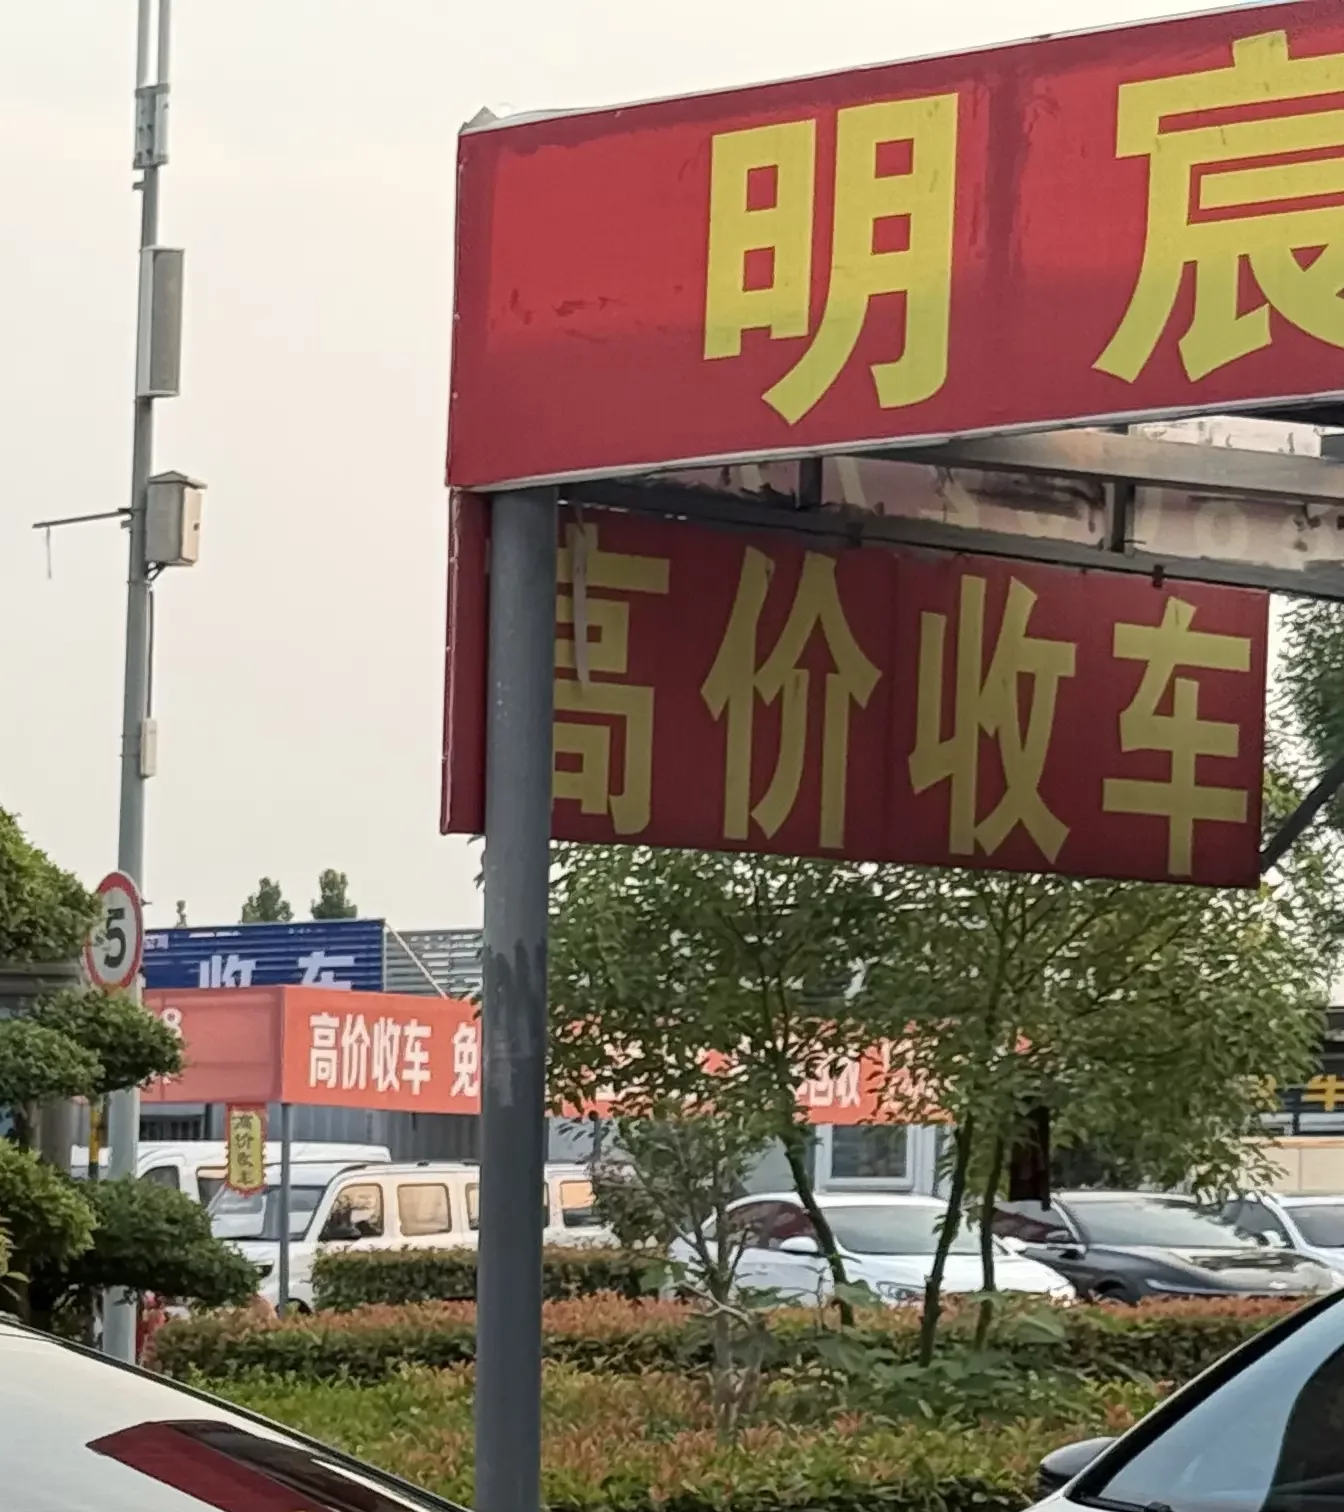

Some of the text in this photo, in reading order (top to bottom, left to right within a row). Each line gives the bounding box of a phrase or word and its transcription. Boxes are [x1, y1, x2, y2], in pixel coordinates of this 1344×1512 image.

[550, 522, 1253, 878] 高价收车
[103, 907, 127, 969] 5
[309, 1012, 432, 1096] 高价收车
